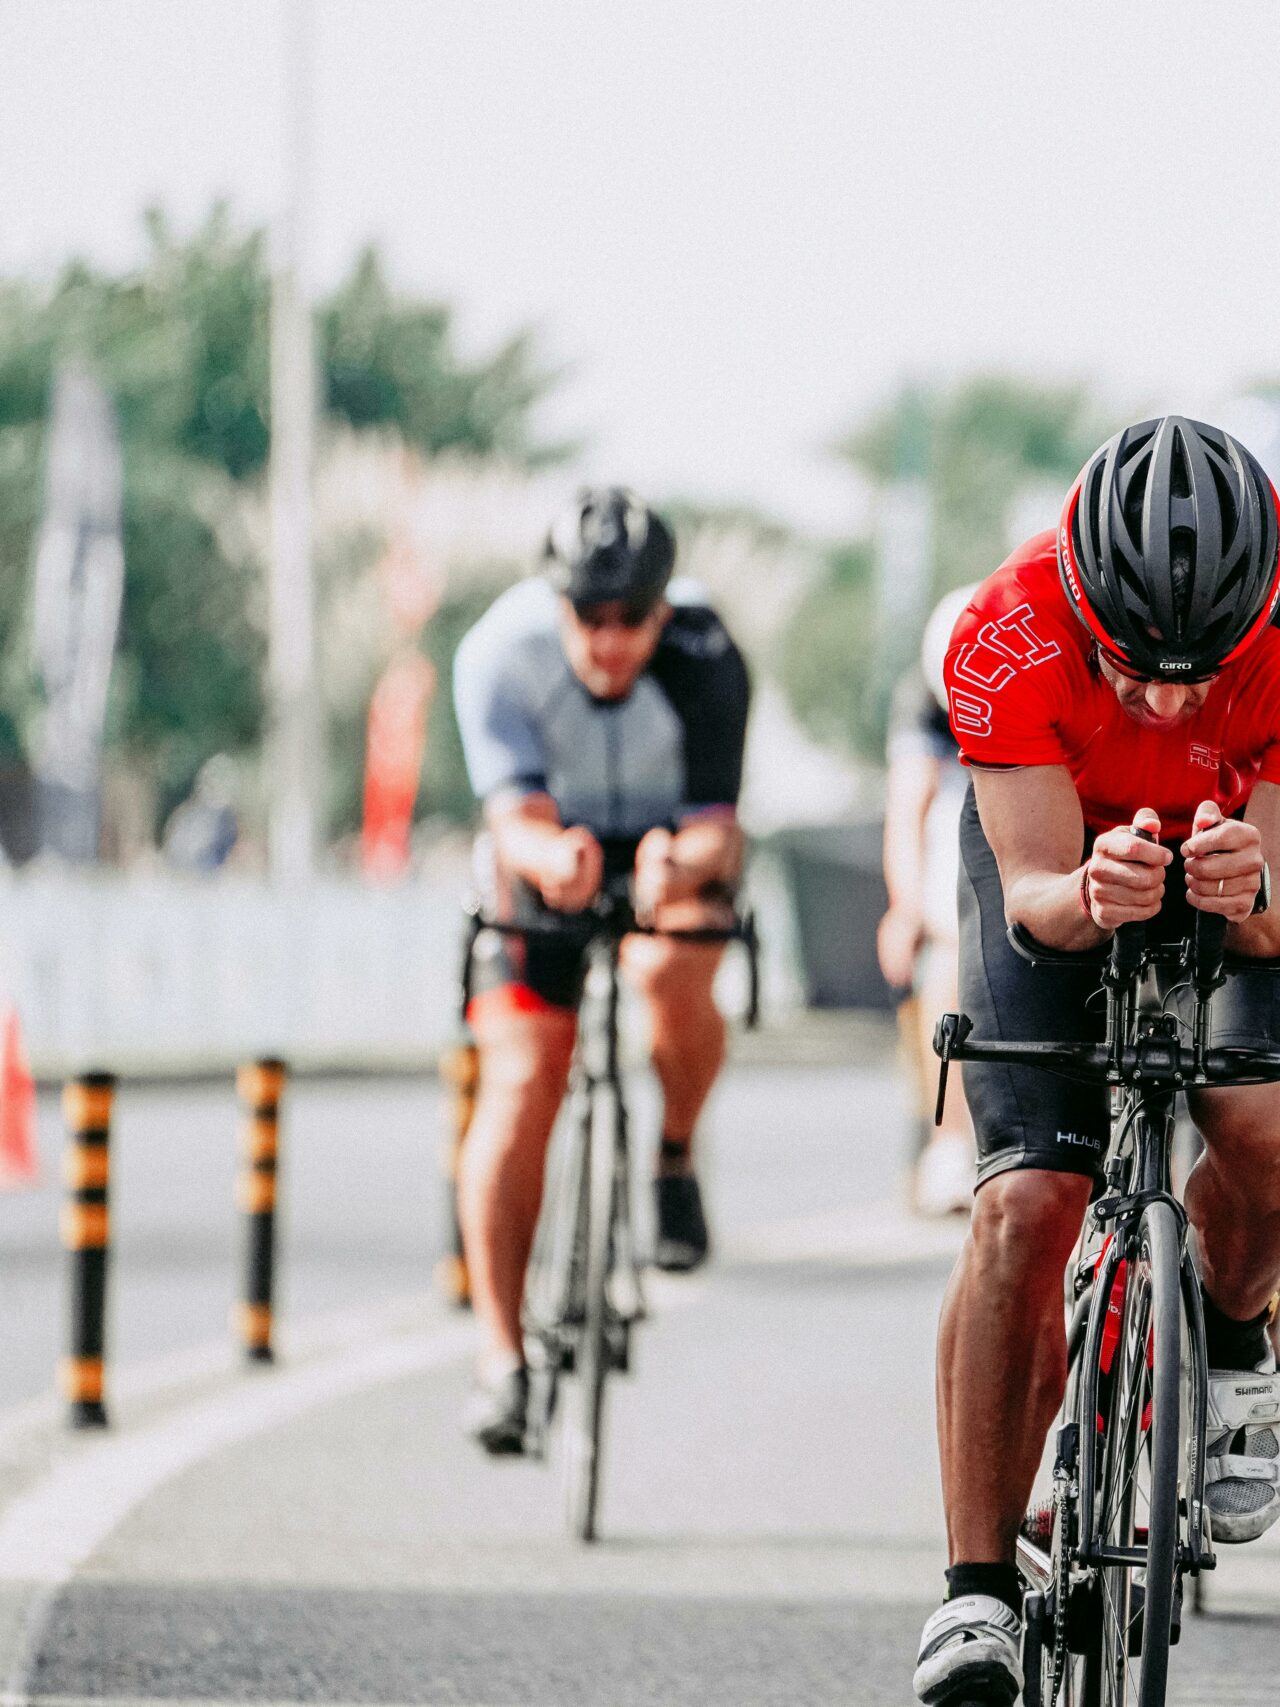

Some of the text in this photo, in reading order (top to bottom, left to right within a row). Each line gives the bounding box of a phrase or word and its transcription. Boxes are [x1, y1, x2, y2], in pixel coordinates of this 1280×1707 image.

[1062, 549, 1082, 601] GIRO
[1159, 662, 1192, 670] GIRO
[1189, 753, 1220, 770] HUU
[1056, 1131, 1101, 1150] HUUB
[1234, 1385, 1273, 1396] SHIMANO
